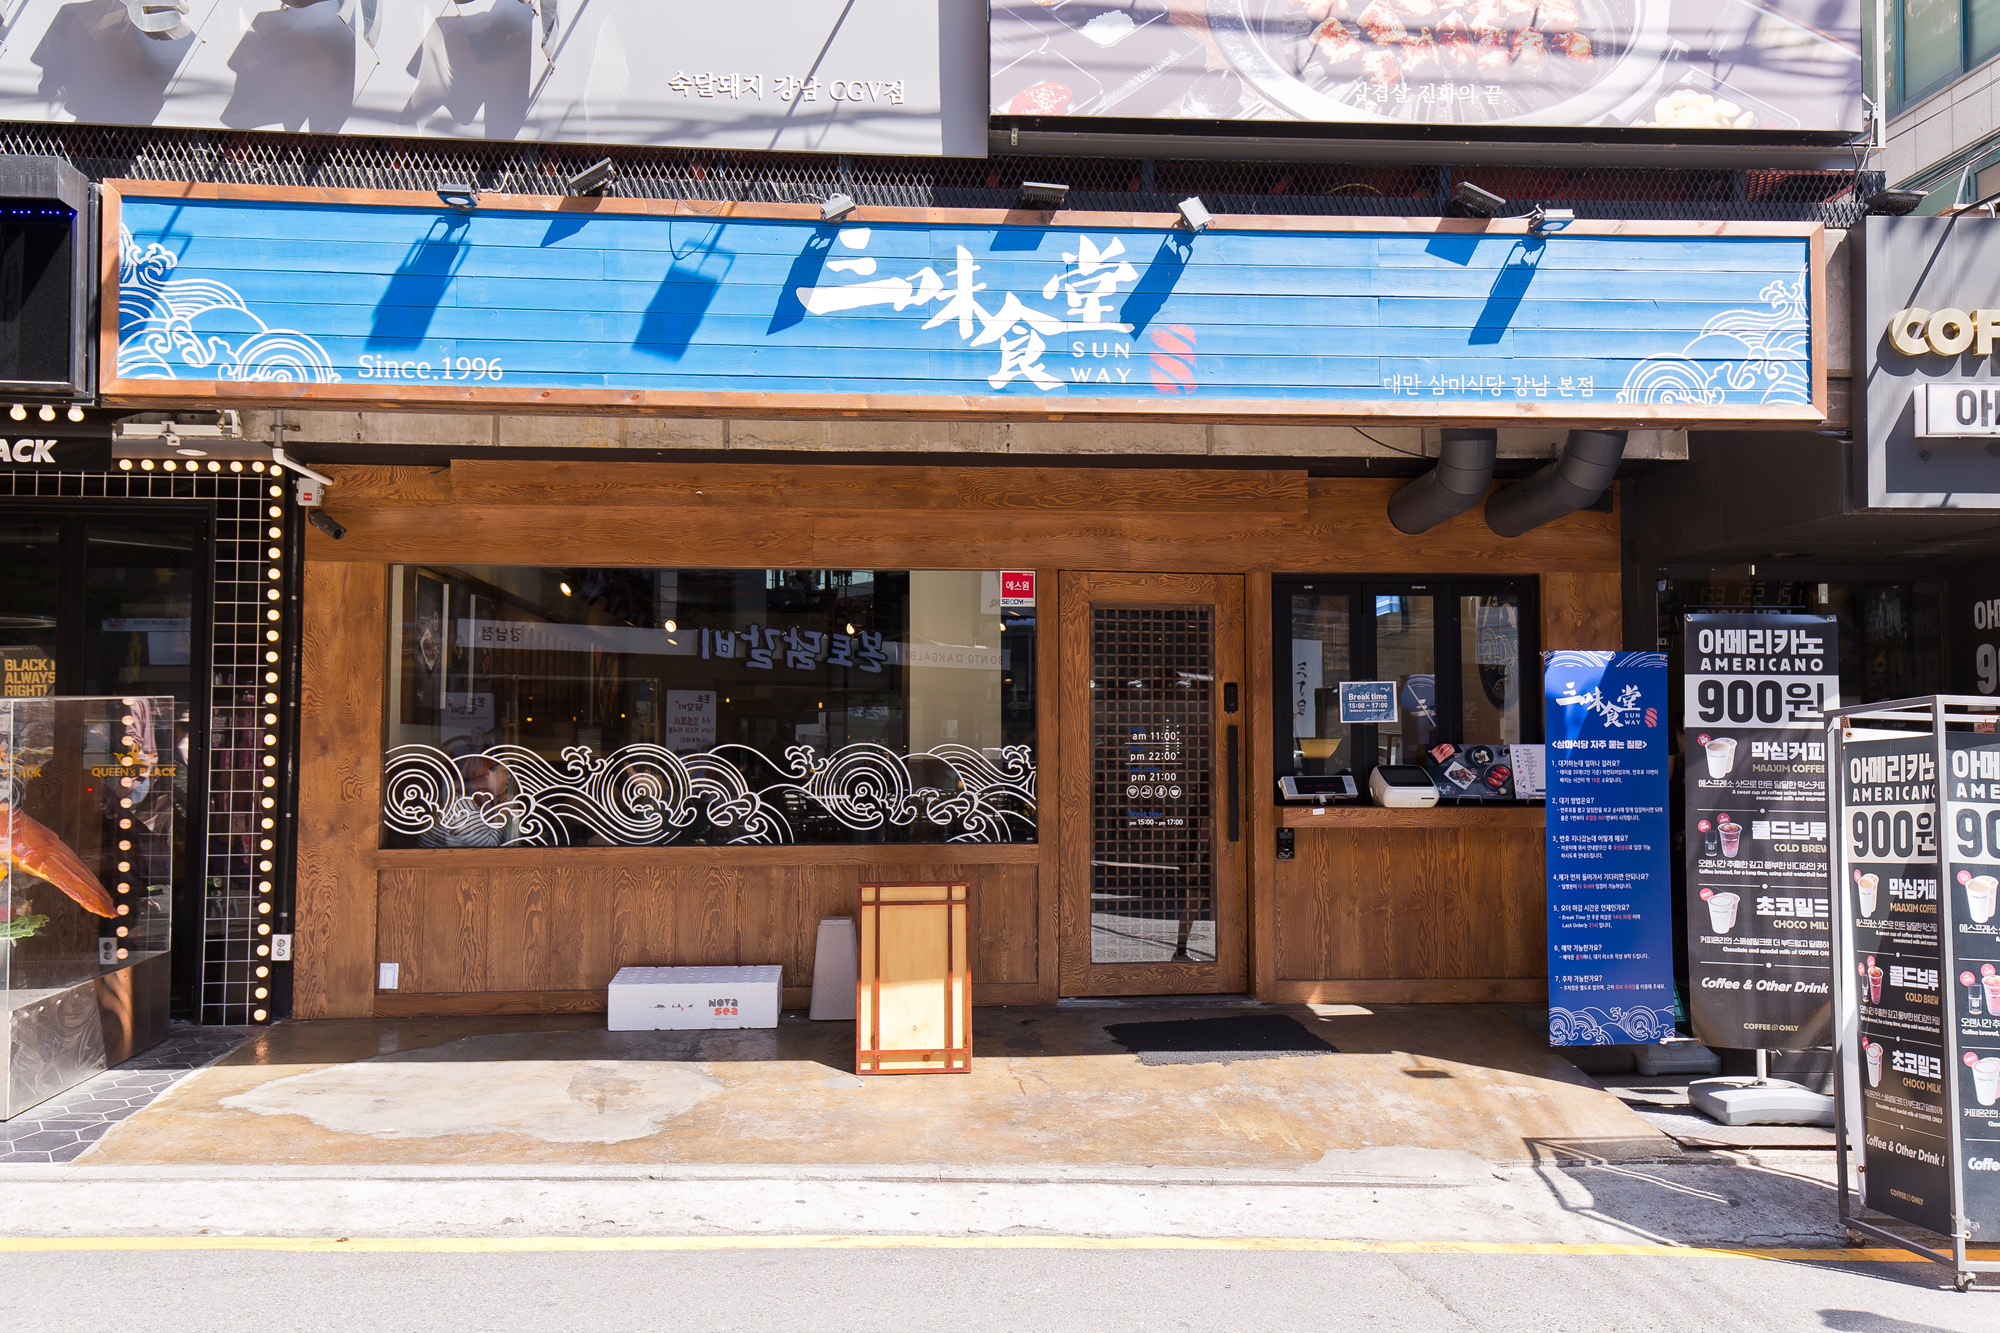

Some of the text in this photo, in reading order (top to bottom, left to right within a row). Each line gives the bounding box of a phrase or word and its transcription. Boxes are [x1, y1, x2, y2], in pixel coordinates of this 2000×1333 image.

[668, 70, 905, 104] 숙달돼지 강남 CGV점
[1351, 82, 1411, 104] 삼겹살
[1417, 83, 1478, 105] 진화의
[796, 227, 1139, 391] 三味食堂
[1072, 341, 1131, 359] SUN
[358, 354, 504, 382] Since.1996
[1070, 366, 1132, 384] WAY
[1383, 373, 1595, 399] 대만 삼미식당 강남 본점
[1005, 580, 1030, 591] 에스원
[1698, 629, 1824, 655] 아메리카노
[4, 659, 48, 671] BLACK
[1700, 657, 1824, 672] AMERICANO
[4, 671, 56, 684] ALWAYS
[4, 684, 48, 696] RIGHT!
[1556, 681, 1641, 728] 三味食堂
[1697, 679, 1825, 724] 900원
[1150, 732, 1176, 740] 11:00
[1590, 740, 1607, 749] 자주
[1751, 742, 1825, 762] 막심커피
[1130, 752, 1177, 762] pm 22:00
[1752, 764, 1825, 774] MAAXIM COFFEE
[1131, 773, 1177, 782] pm 21:00
[1758, 781, 1774, 789] 만든
[1774, 843, 1799, 853] COLD
[1889, 878, 1937, 900] 막심커피
[1890, 902, 1937, 914] MAAXIM COFFEE
[1773, 920, 1807, 930] CHOCO
[1701, 977, 1829, 994] Coffee & Other Drink
[1905, 992, 1939, 1006] COLD BREW
[714, 1007, 738, 1016] sea
[1743, 1022, 1799, 1032] COFFEE ONLY
[1892, 1050, 1942, 1080] 초코밀크
[1903, 1077, 1942, 1094] CHOCO MILK
[1866, 1133, 1887, 1150] Coffee
[1888, 1140, 1894, 1152] &
[1895, 1142, 1918, 1159] Other
[1918, 1149, 1940, 1166] Drink
